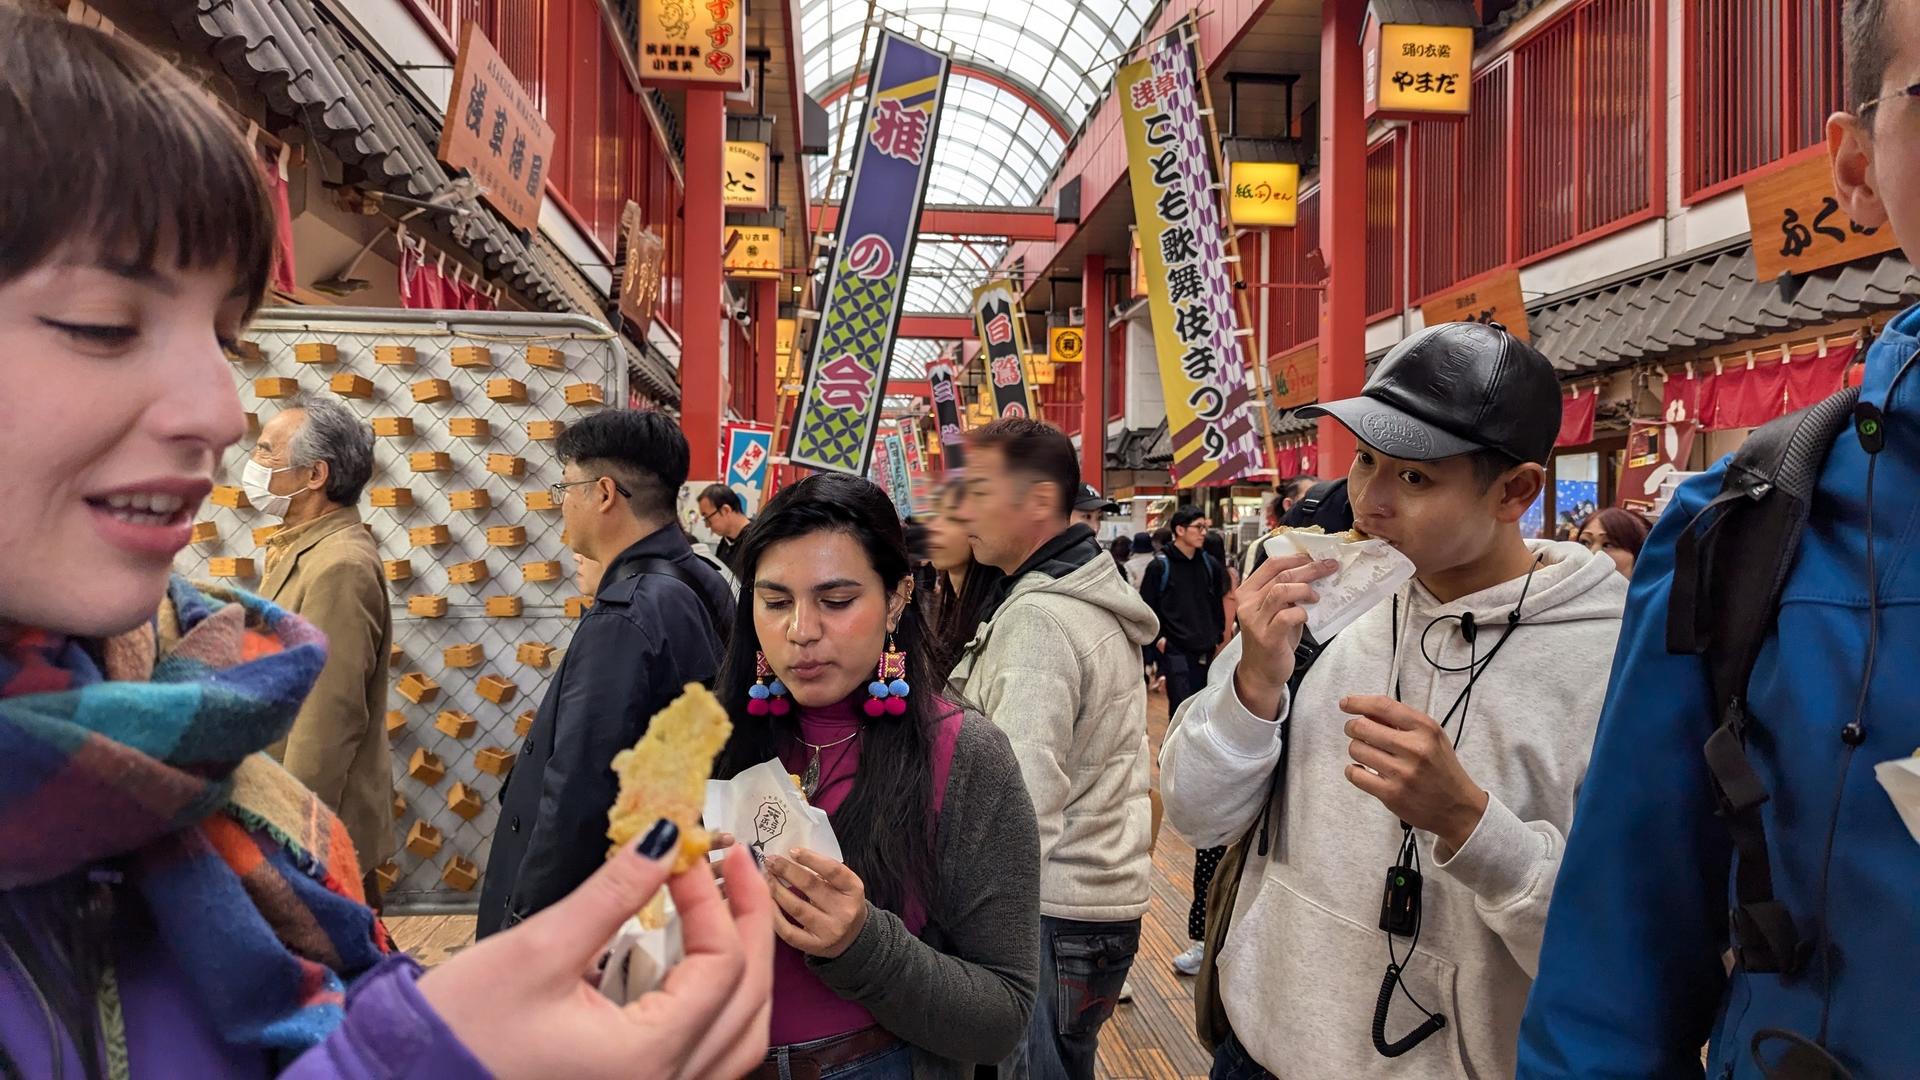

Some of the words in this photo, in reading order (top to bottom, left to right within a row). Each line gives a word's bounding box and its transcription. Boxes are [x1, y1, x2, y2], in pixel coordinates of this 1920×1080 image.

[1131, 72, 1178, 109] 浅草
[1392, 71, 1459, 94] やまだ
[820, 99, 927, 415] 雅の会
[1143, 114, 1228, 461] こども歌舞伎まつり
